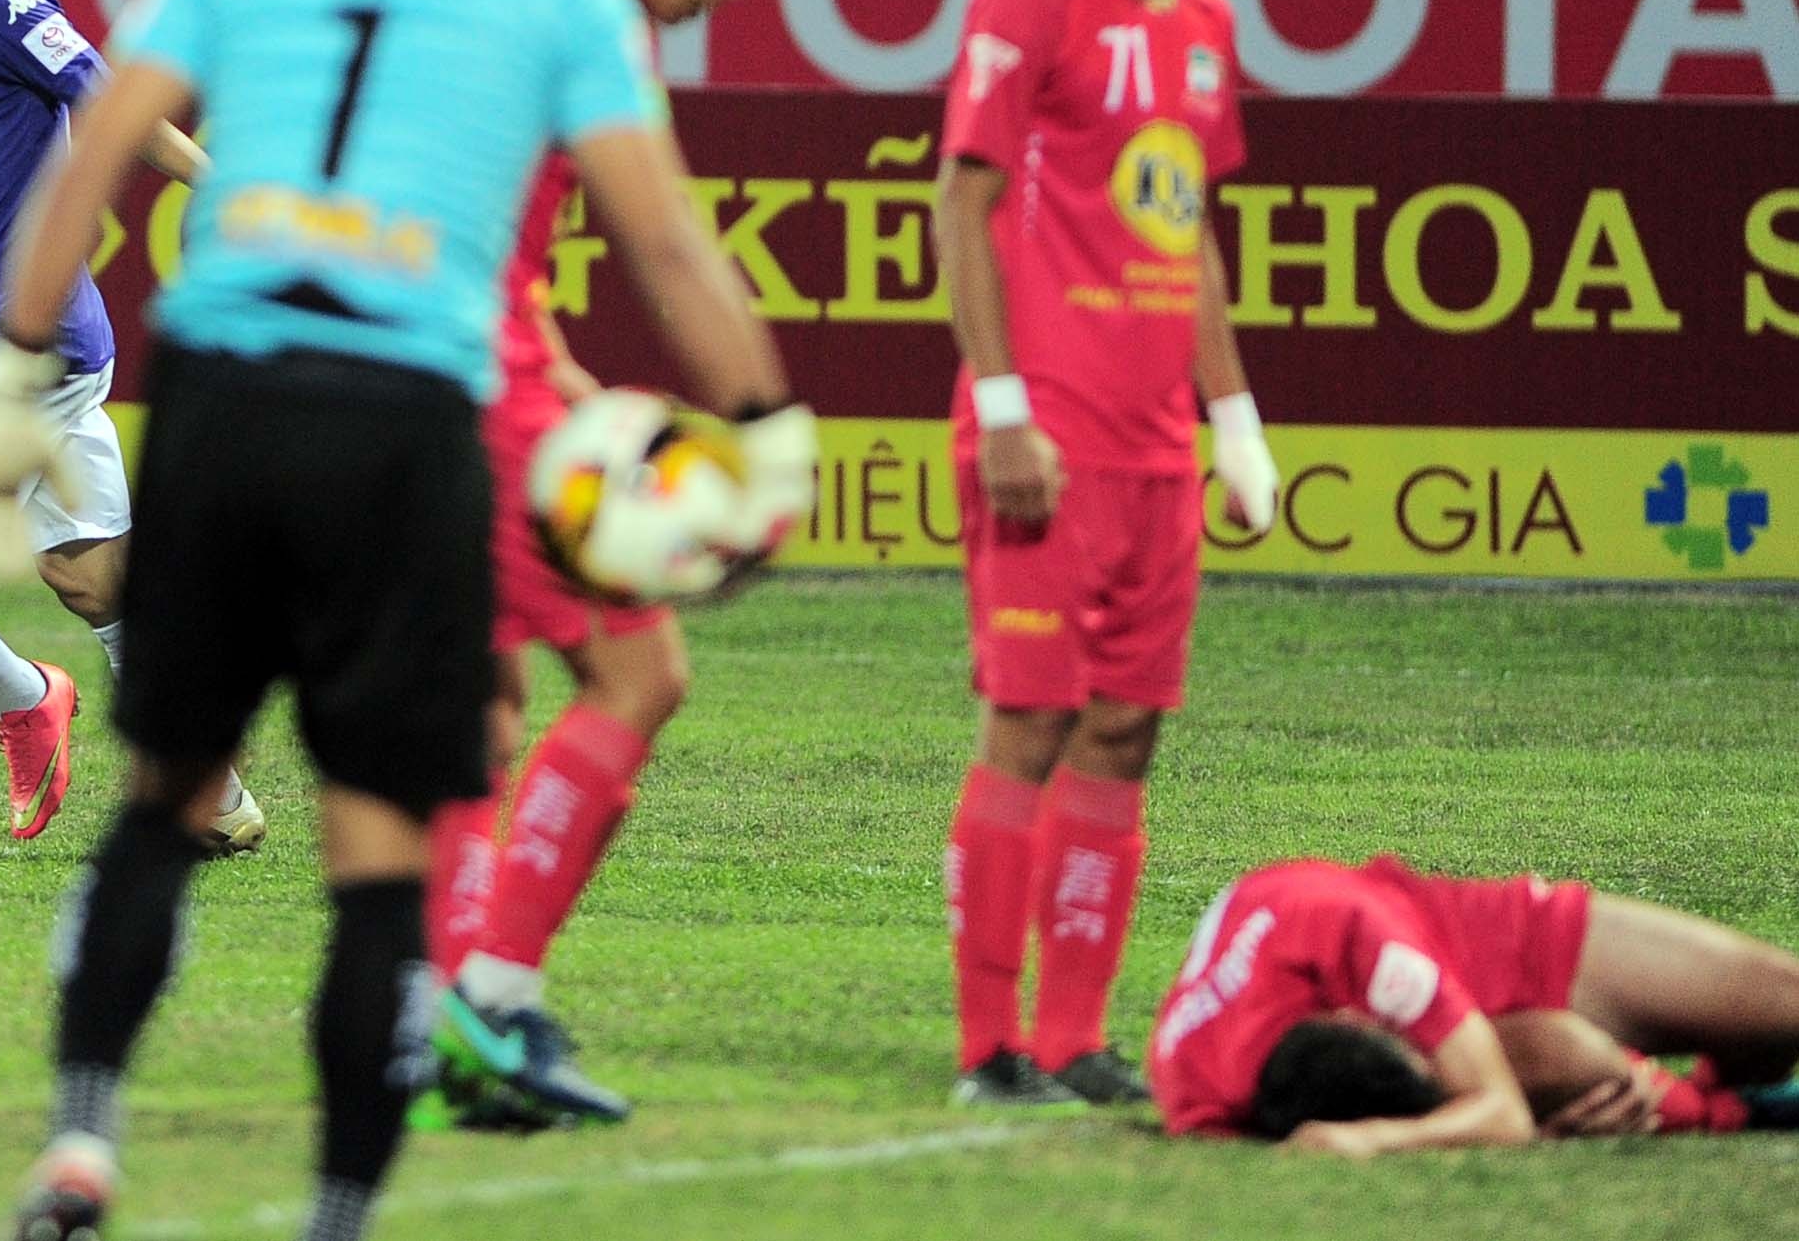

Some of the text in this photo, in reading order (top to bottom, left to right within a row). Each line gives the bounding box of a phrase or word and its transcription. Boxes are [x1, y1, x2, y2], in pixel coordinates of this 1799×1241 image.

[330, 1, 385, 179] 1
[1097, 23, 1156, 113] 71
[1218, 183, 1682, 335] HOA
[1395, 463, 1584, 558] GIA
